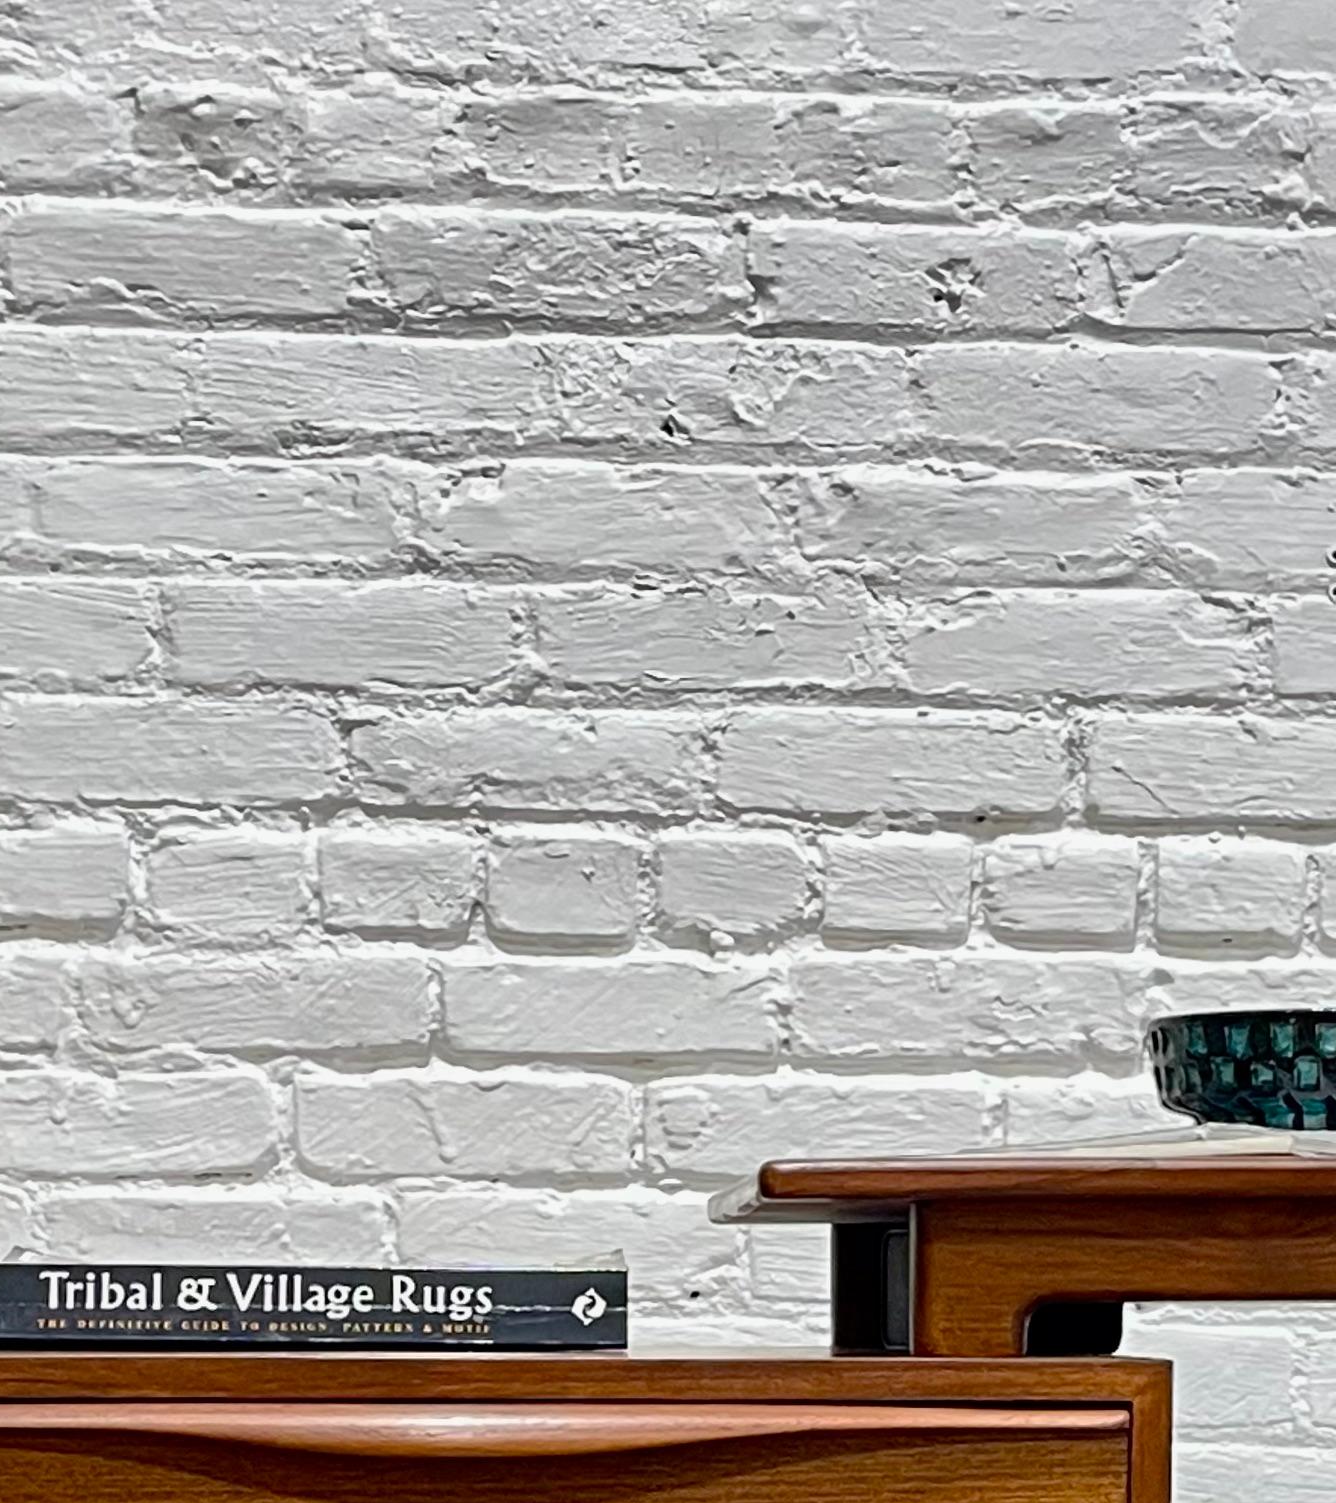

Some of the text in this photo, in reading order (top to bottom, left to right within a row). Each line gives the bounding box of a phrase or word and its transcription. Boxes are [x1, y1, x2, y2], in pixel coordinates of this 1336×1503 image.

[38, 1270, 164, 1311] Tribal
[177, 1277, 218, 1312] &
[226, 1273, 375, 1320] Village
[391, 1274, 493, 1322] Rugs
[37, 1318, 68, 1329] THE
[77, 1319, 172, 1331] DEFINITIVE
[181, 1320, 230, 1331] GUIDE
[240, 1321, 261, 1331] TO
[342, 1322, 415, 1334] PATTERN
[422, 1323, 433, 1334] &
[442, 1323, 492, 1334] MOTIF
